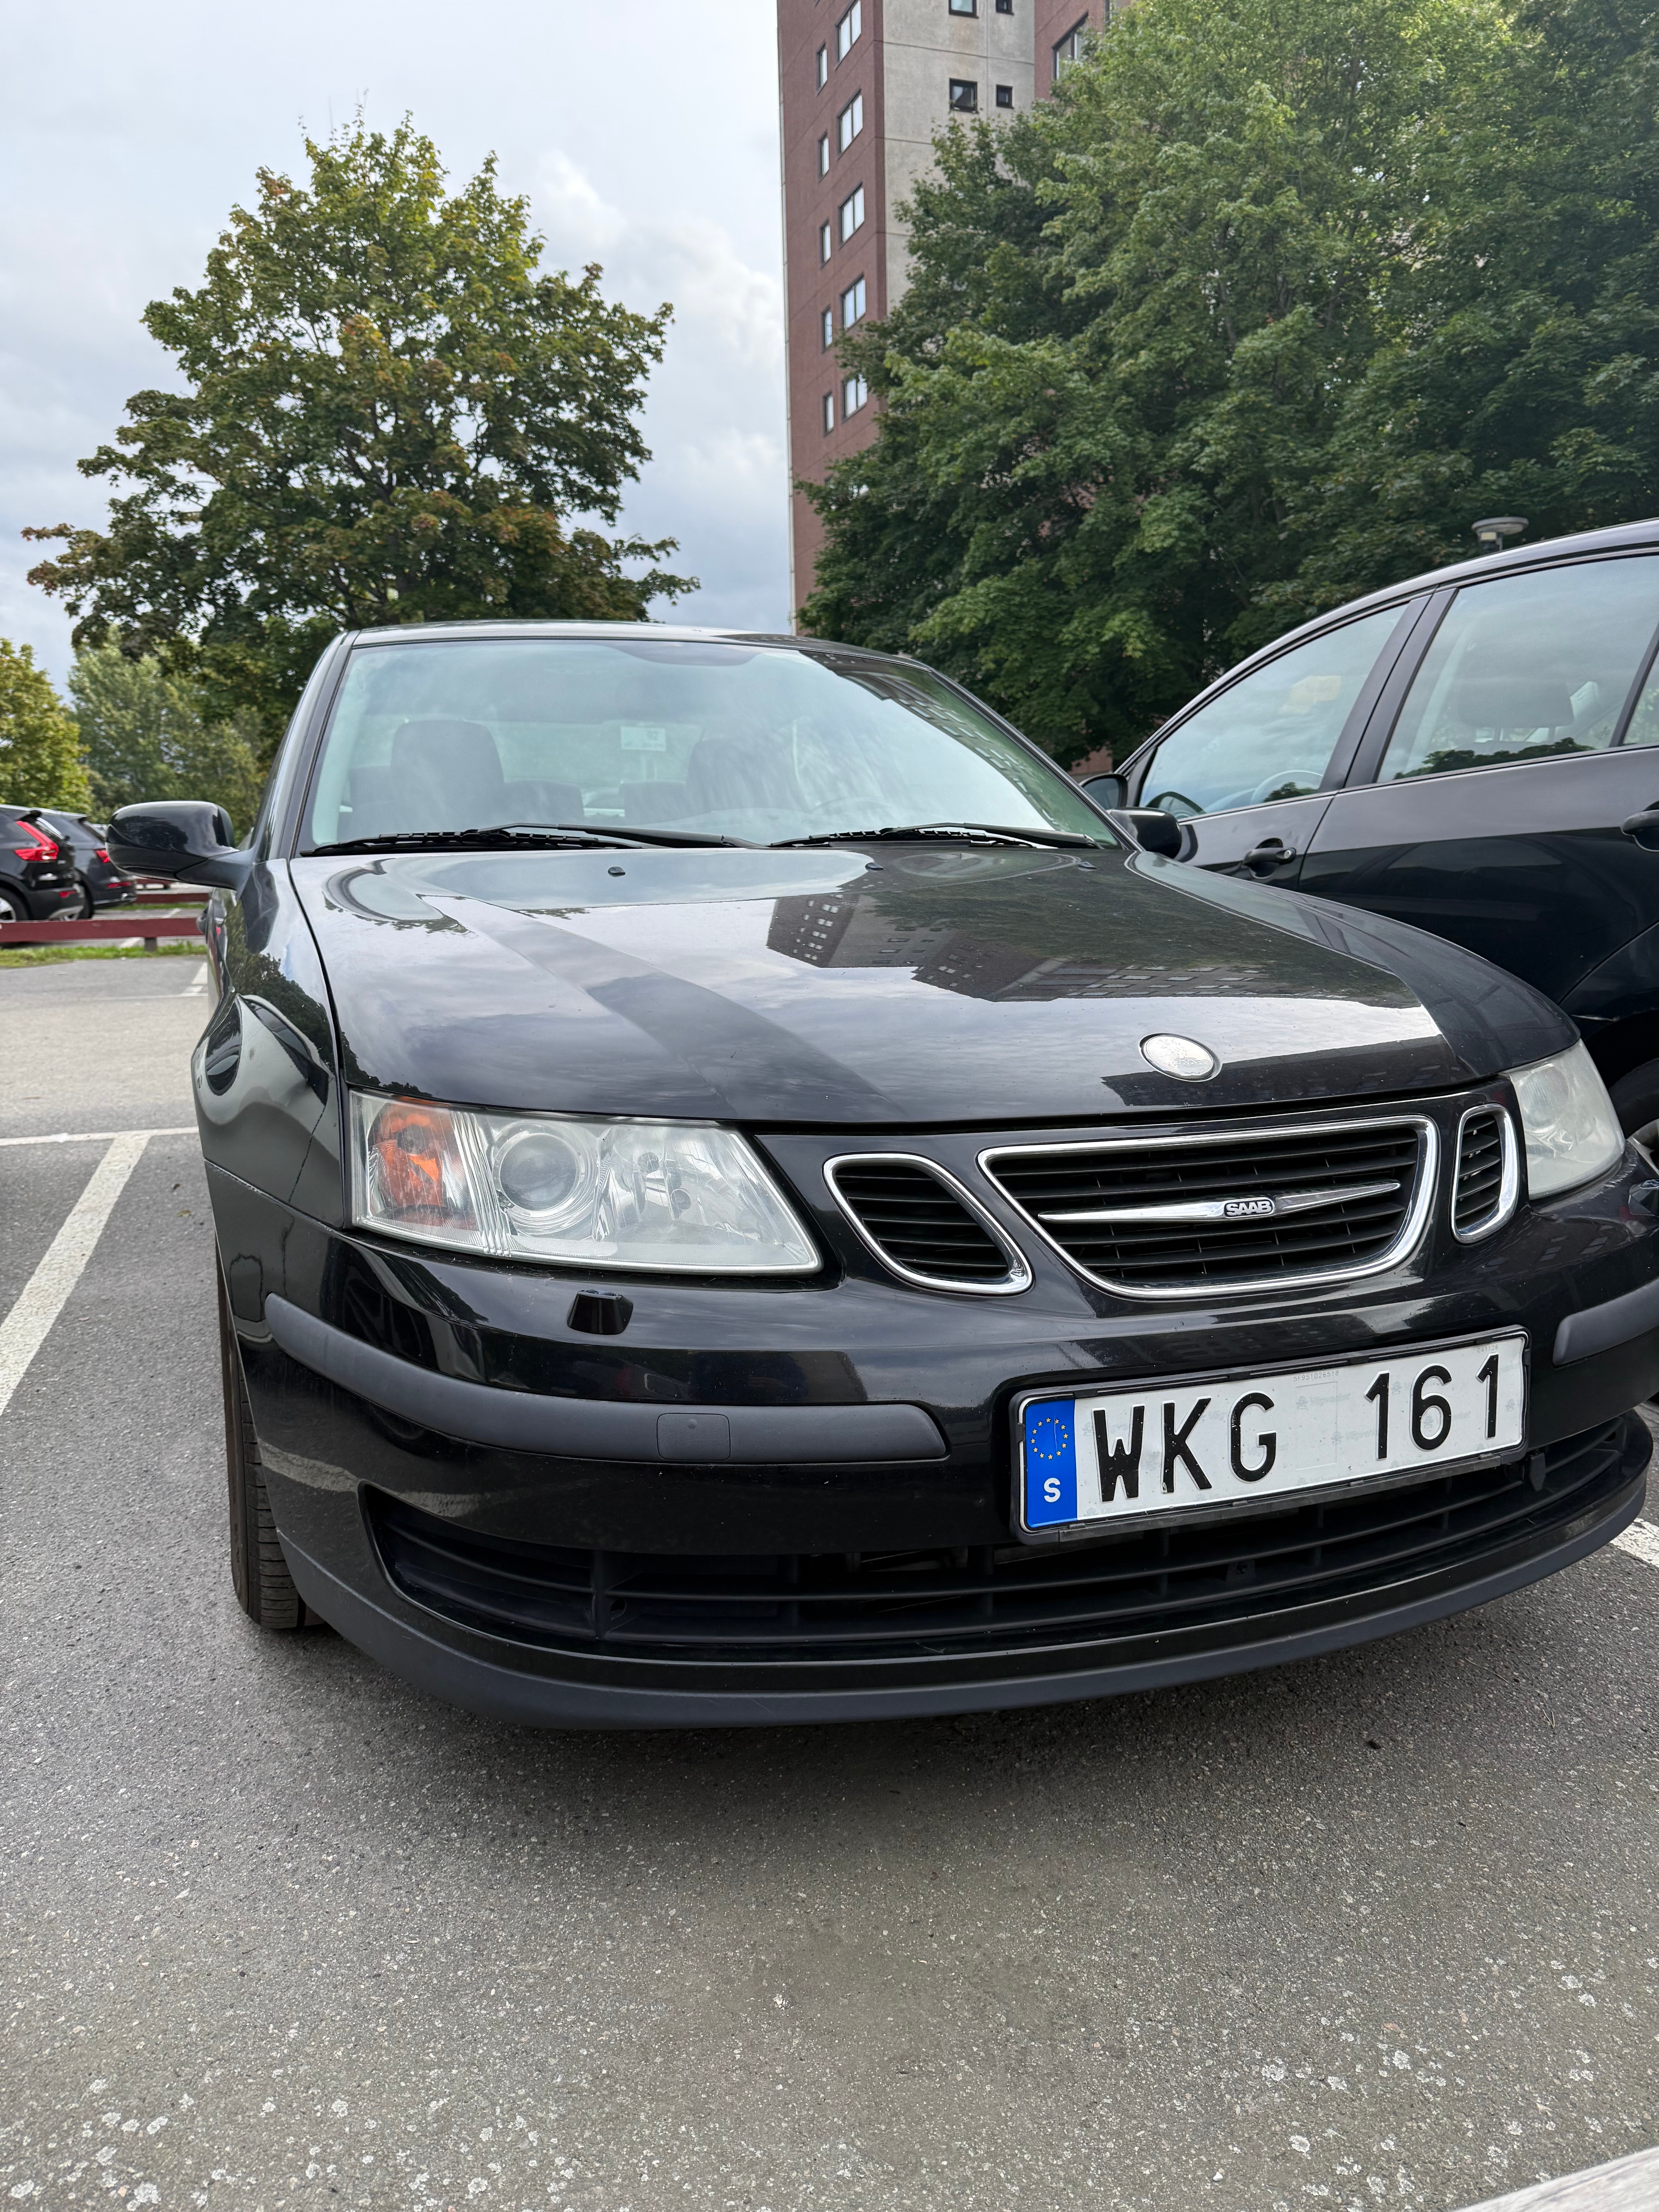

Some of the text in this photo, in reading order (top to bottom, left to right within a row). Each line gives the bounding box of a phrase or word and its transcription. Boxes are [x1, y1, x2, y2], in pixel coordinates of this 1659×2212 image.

[1226, 1201, 1272, 1216] SAAB
[1093, 1354, 1499, 1502] WKG 161
[1044, 1477, 1061, 1503] S
